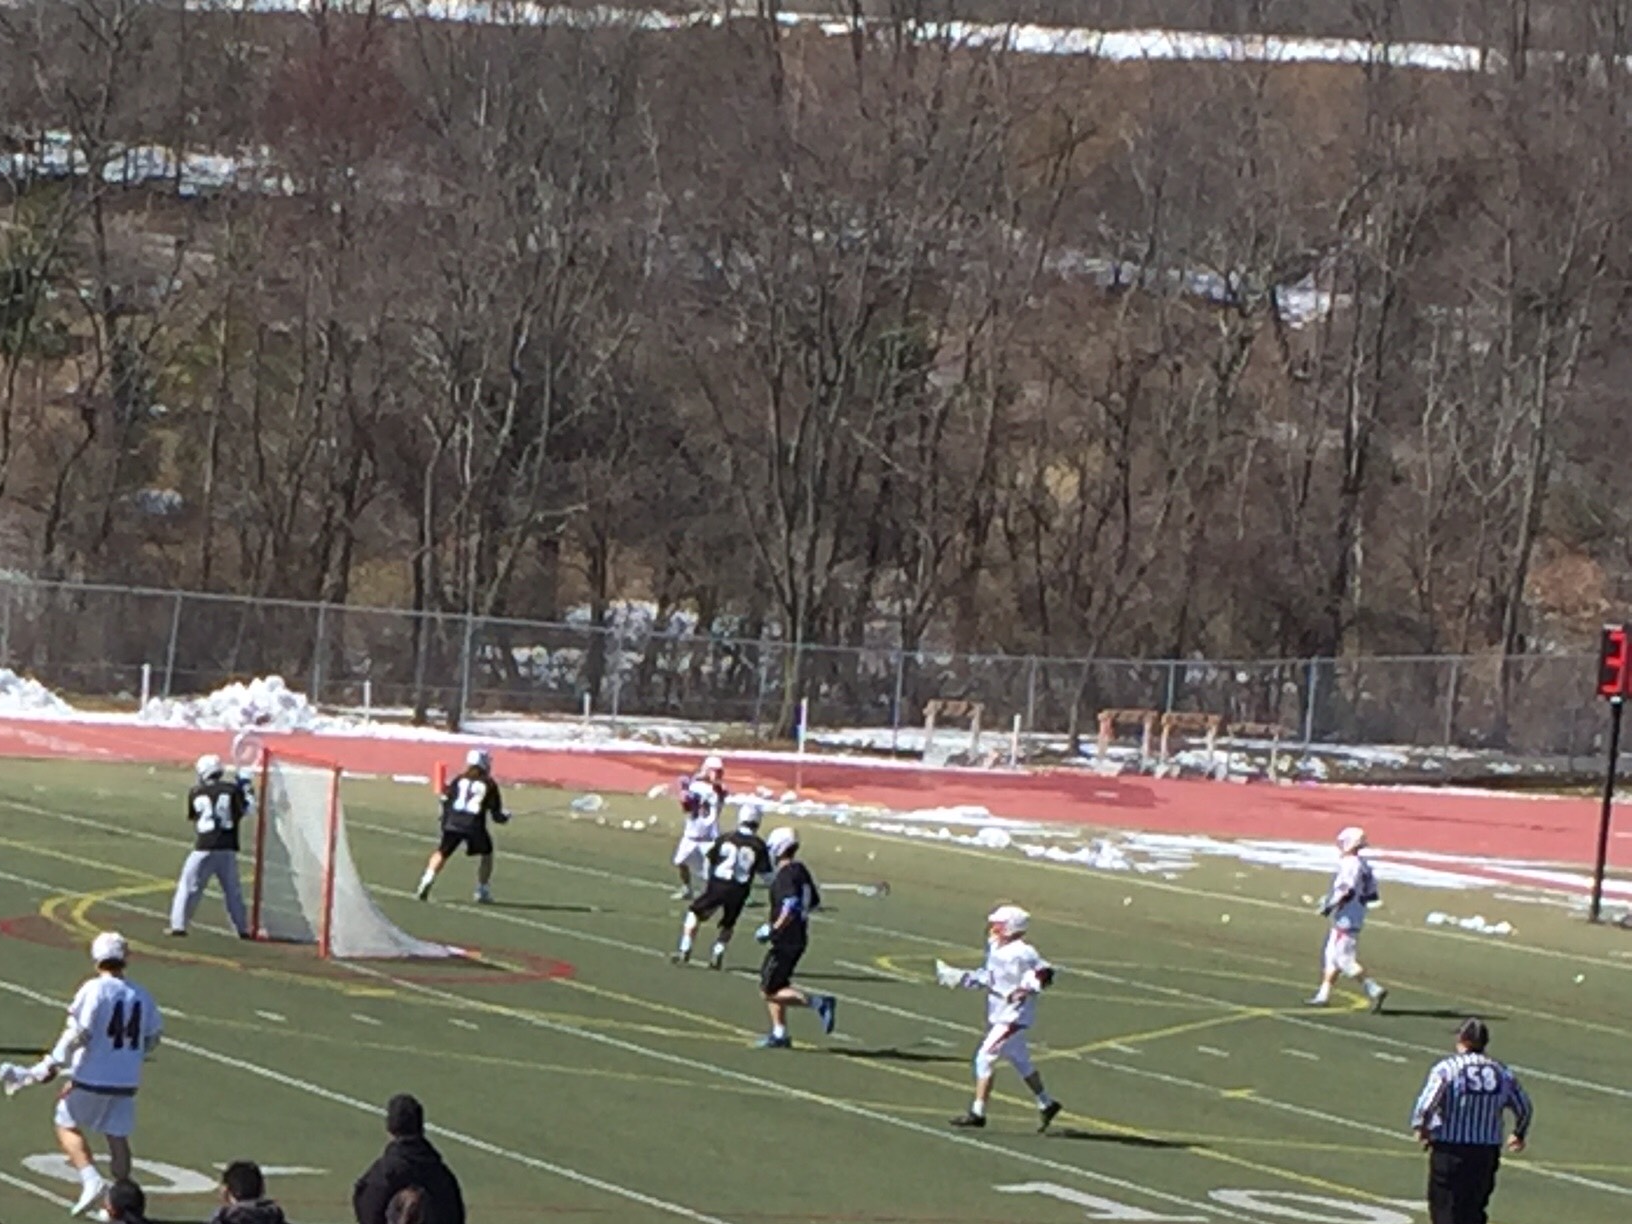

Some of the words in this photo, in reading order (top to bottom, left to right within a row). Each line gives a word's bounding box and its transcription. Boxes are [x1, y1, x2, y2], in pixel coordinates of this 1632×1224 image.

[1600, 631, 1628, 694] 3
[452, 778, 486, 814] 12
[106, 999, 141, 1049] 44
